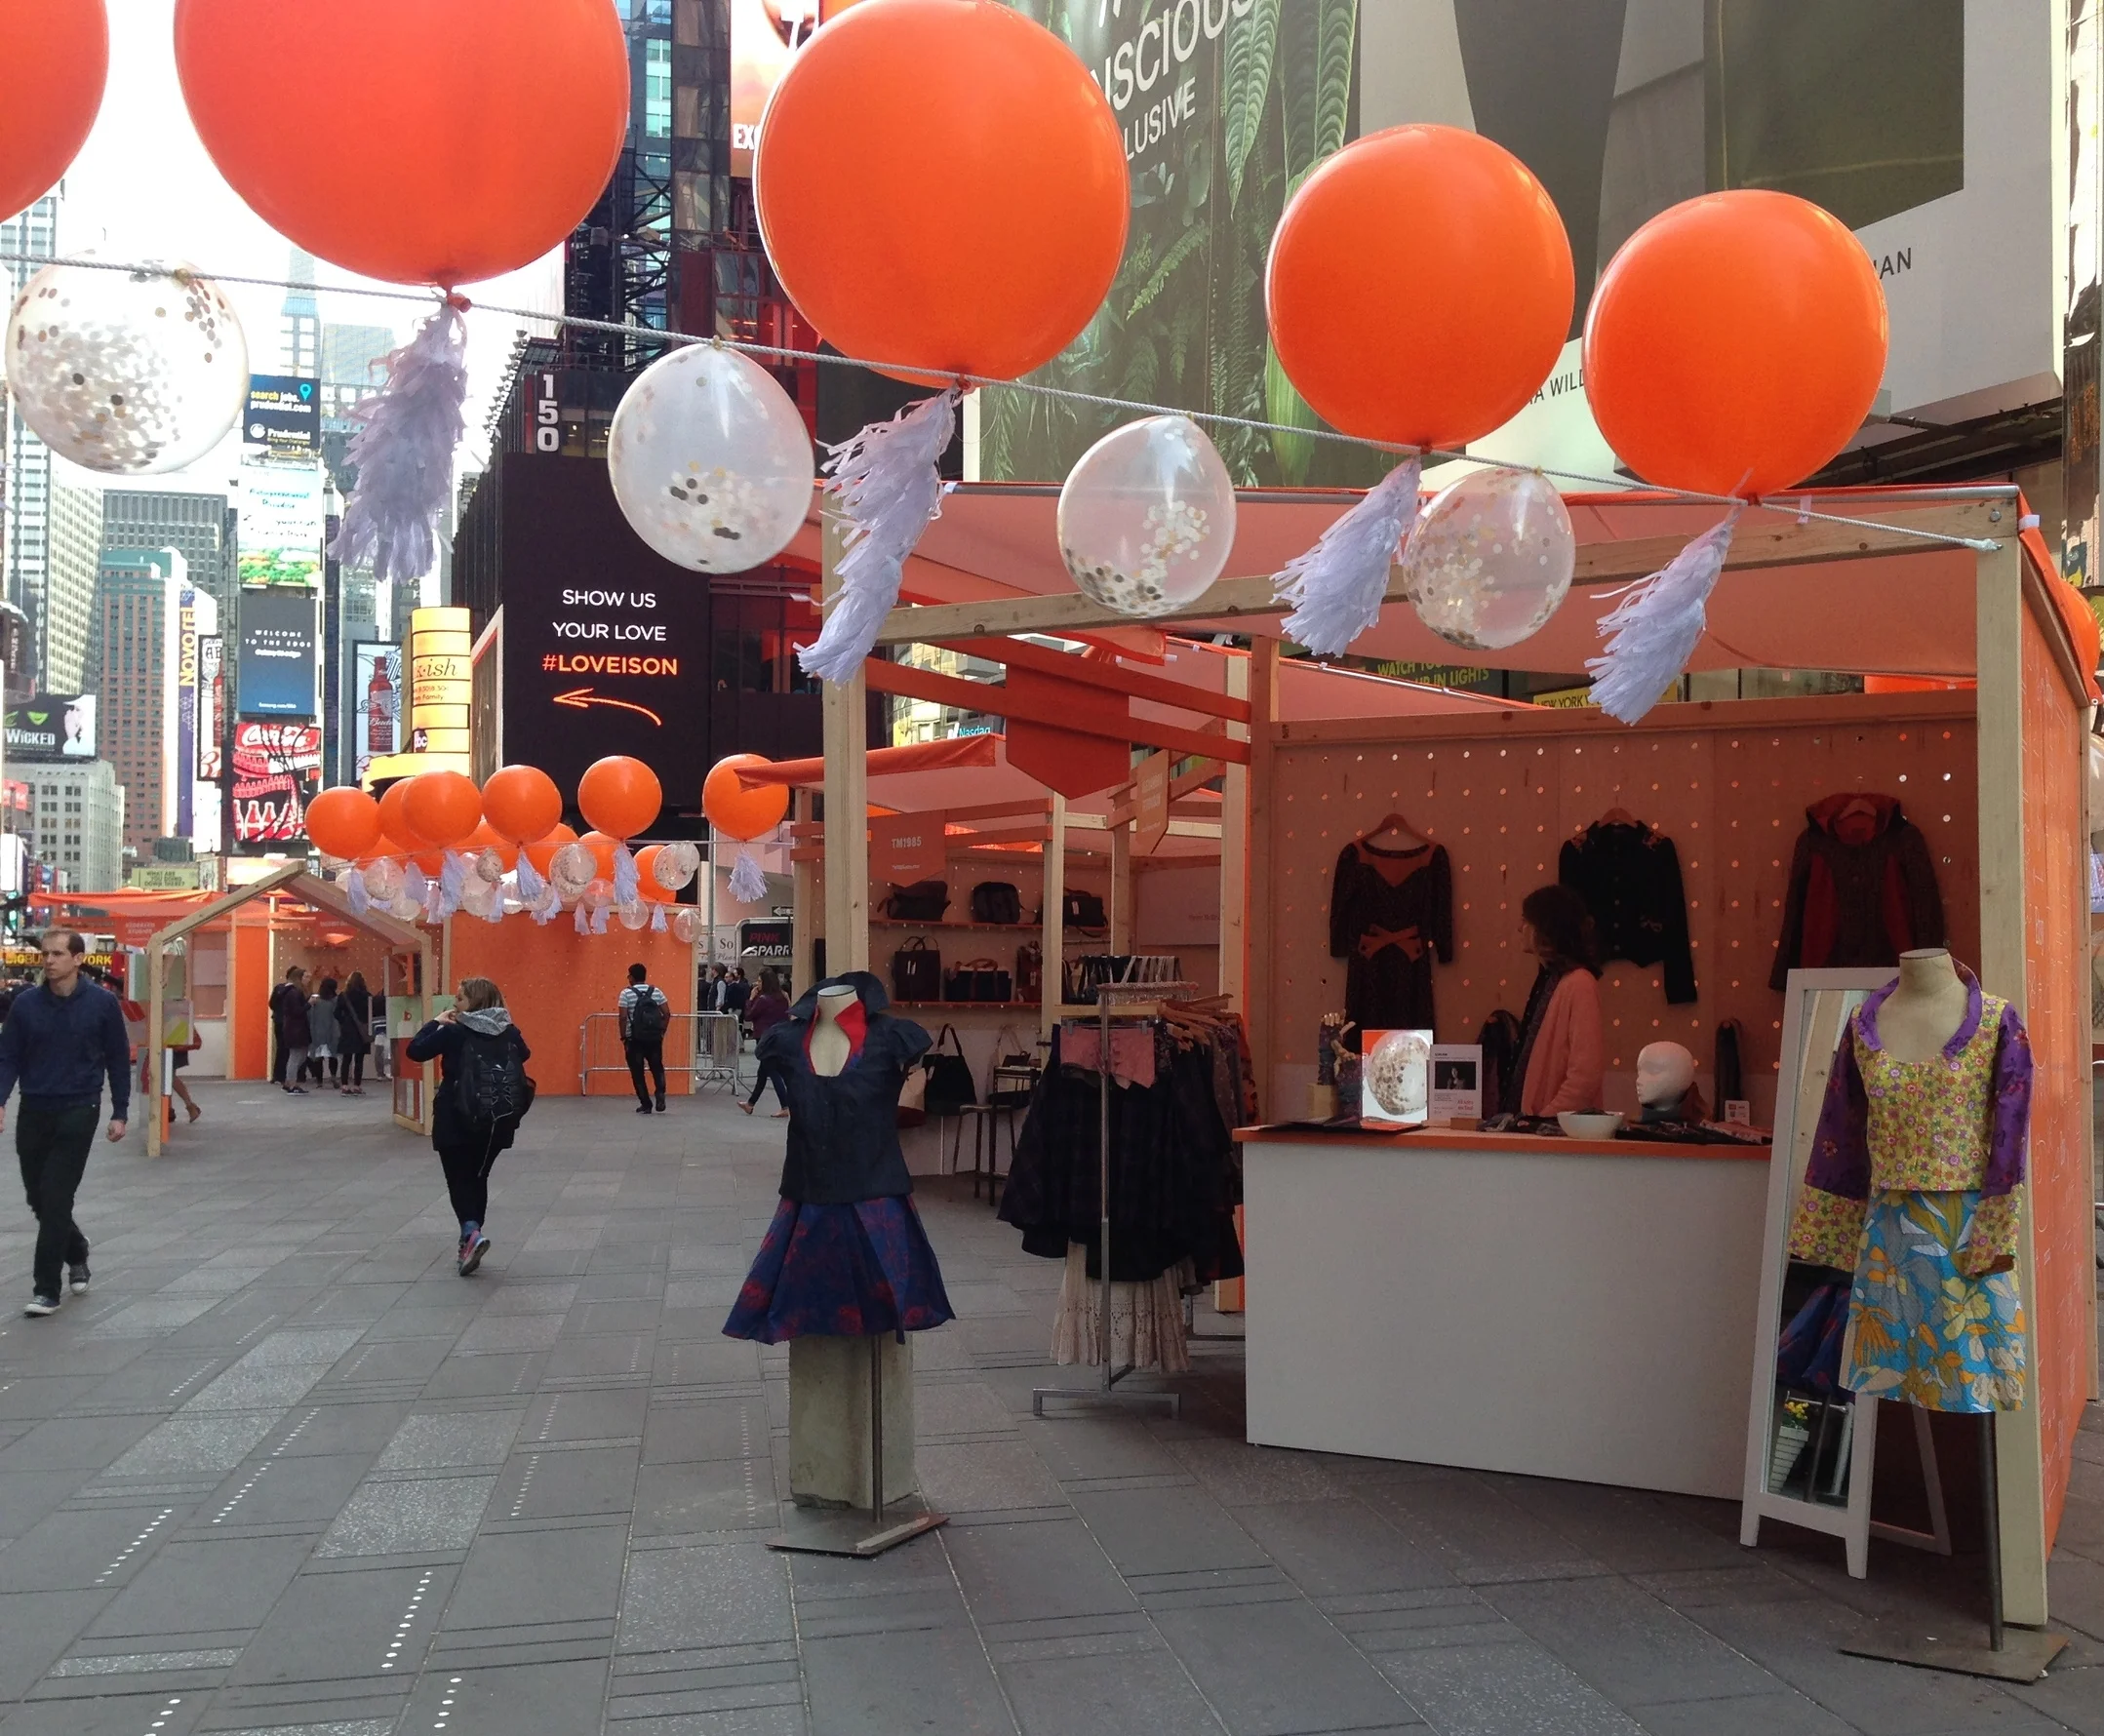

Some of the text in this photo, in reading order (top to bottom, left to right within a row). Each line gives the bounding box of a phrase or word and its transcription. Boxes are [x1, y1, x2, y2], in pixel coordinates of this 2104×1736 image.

[562, 589, 656, 609] SHOW US
[552, 621, 667, 642] YOUR LOVE
[179, 607, 196, 687] NOVOTEL
[542, 653, 678, 676] #LOVEISON
[1377, 662, 1415, 677] WATCH
[1558, 694, 1584, 708] YORK
[891, 836, 922, 848] TM1985
[749, 931, 781, 943] PINK
